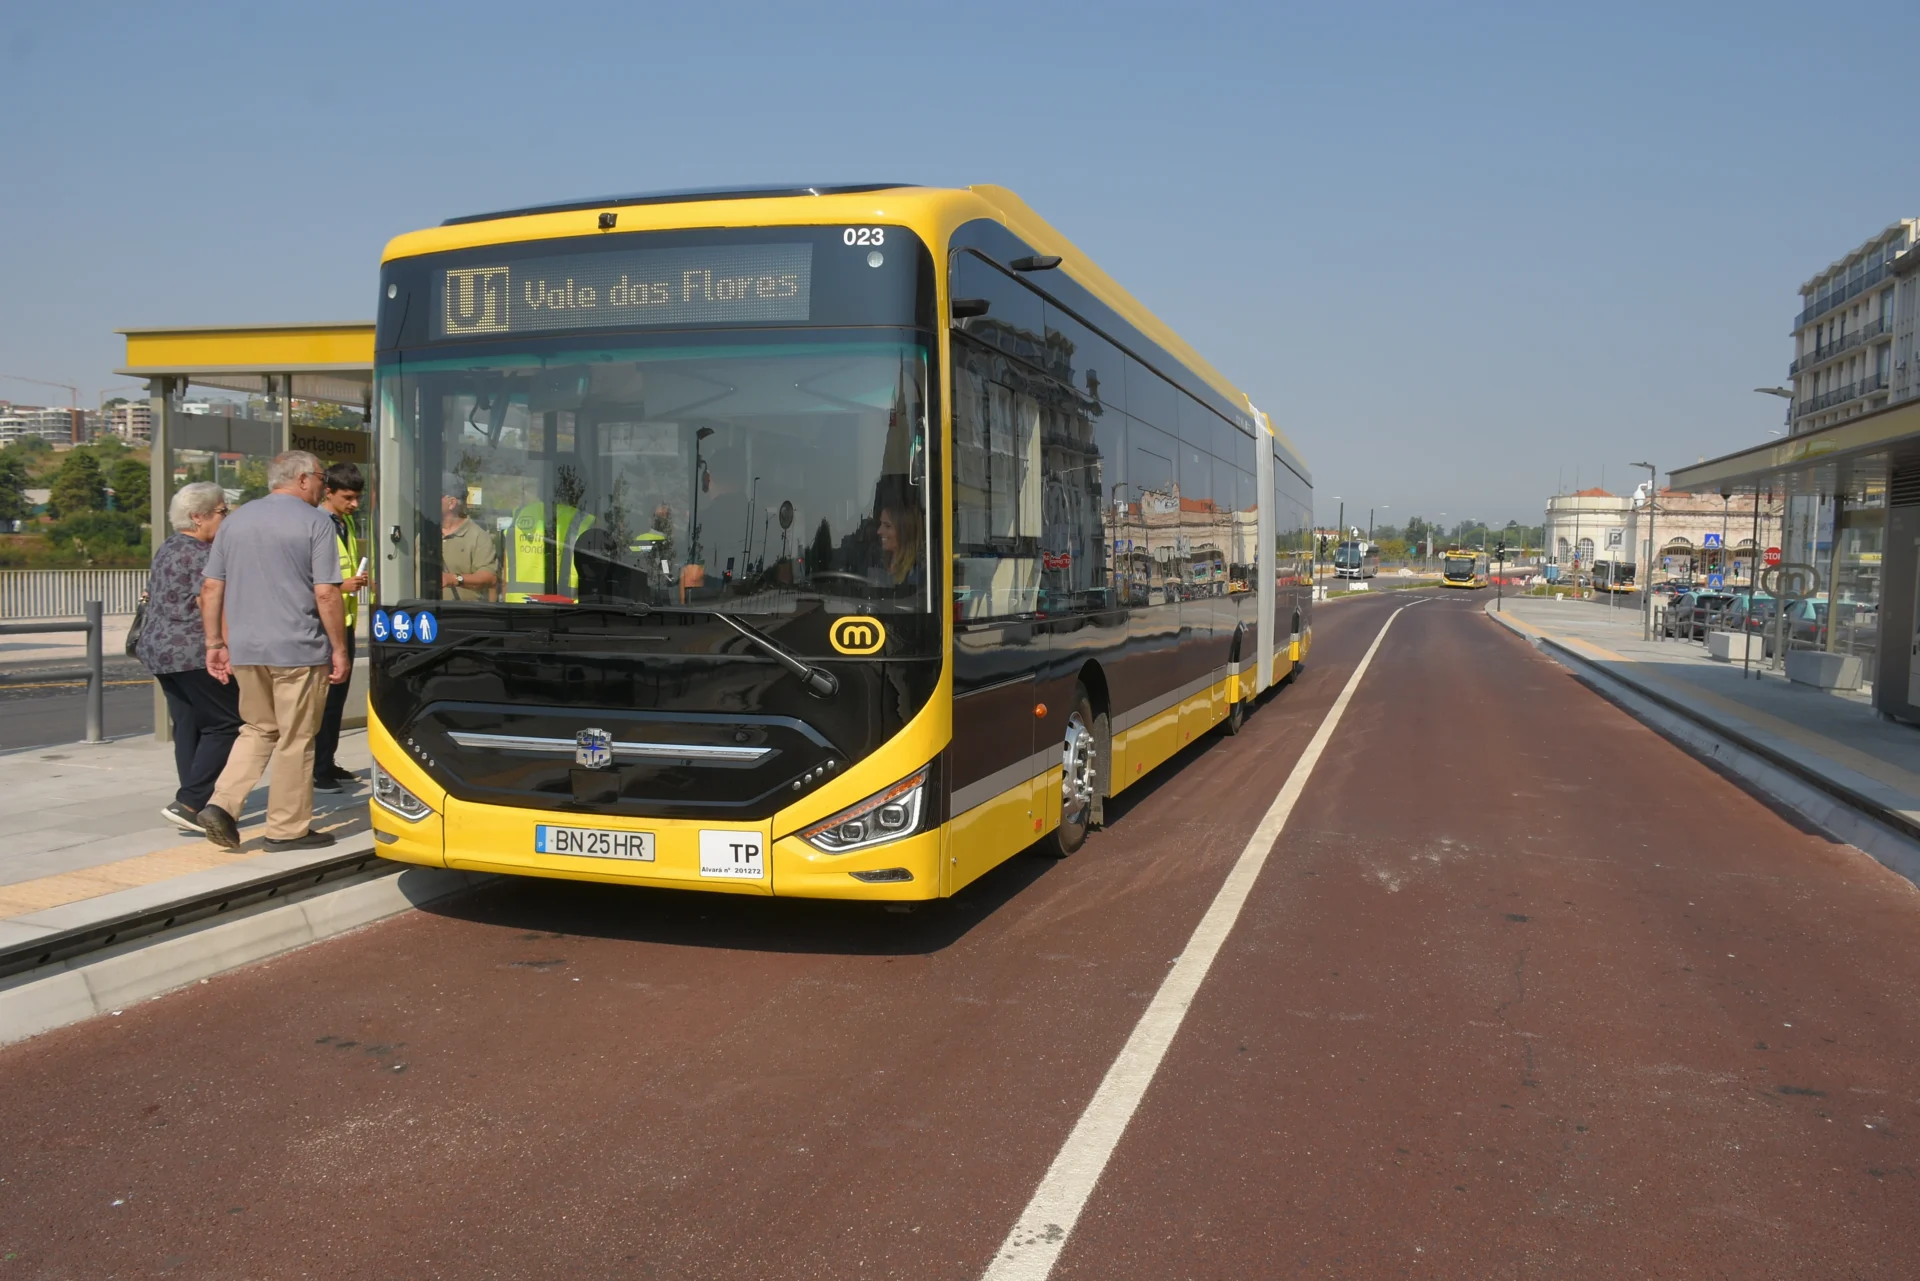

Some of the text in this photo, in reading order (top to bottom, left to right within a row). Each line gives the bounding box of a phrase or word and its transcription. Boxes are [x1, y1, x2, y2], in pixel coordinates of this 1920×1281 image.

[843, 227, 885, 246] 023
[525, 269, 798, 310] Vale das Flores
[729, 843, 759, 863] TP
